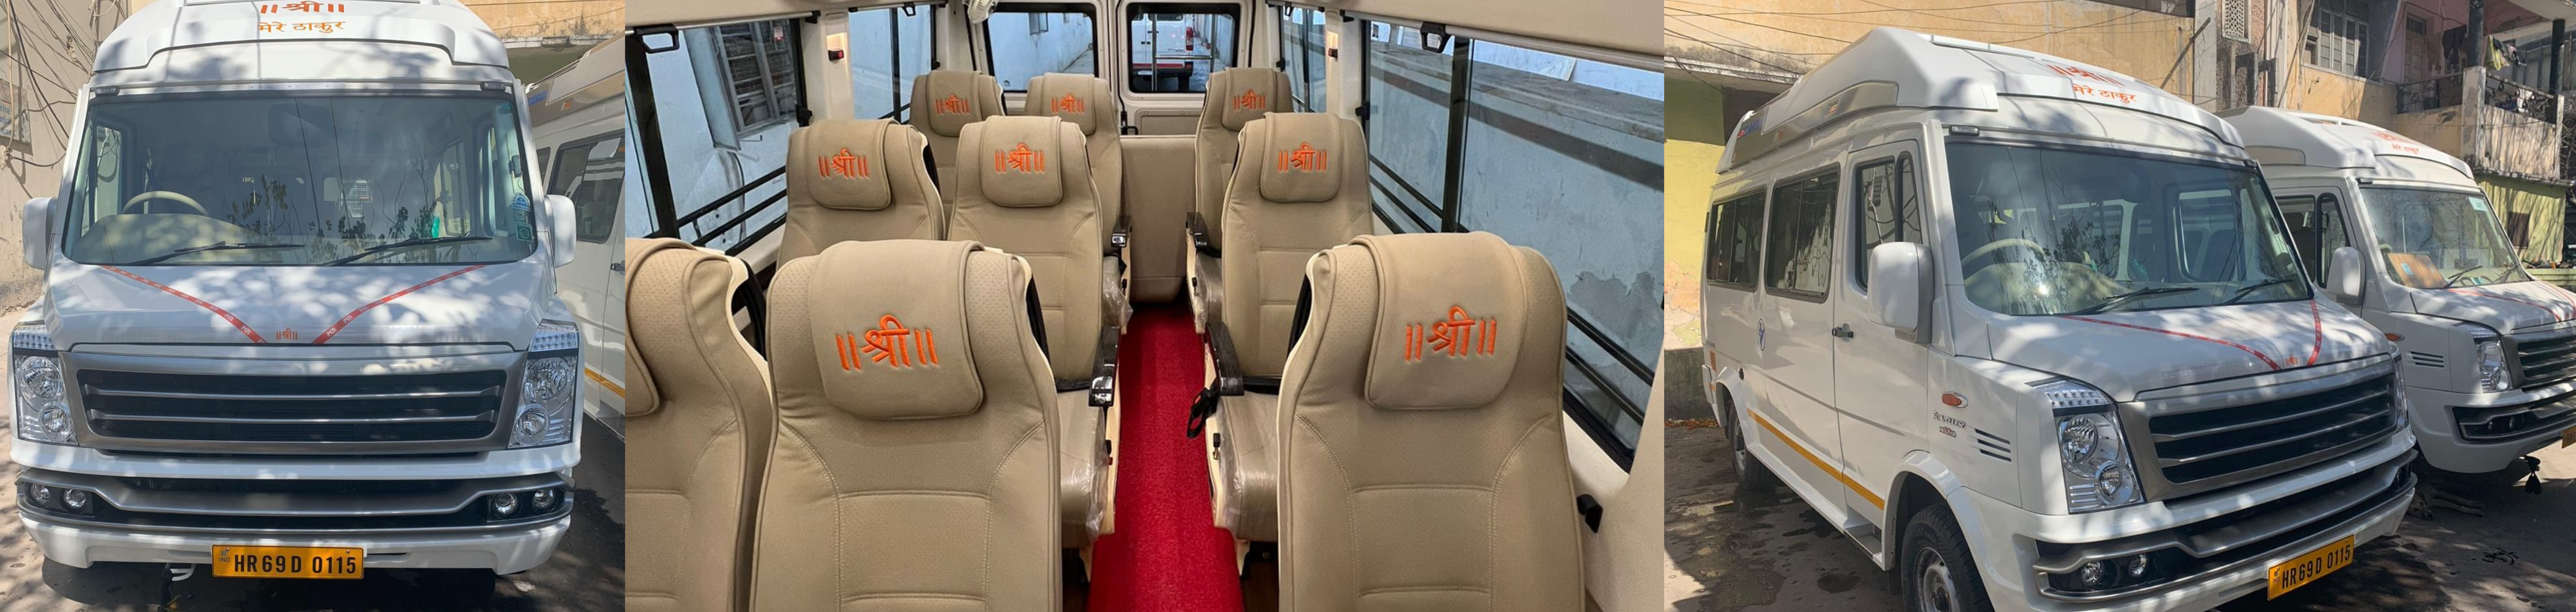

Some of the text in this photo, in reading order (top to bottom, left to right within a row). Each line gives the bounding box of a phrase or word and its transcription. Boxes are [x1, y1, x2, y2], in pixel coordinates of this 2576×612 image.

[257, 21, 346, 33] मेरे ठाकुर
[2073, 83, 2137, 103] मेरे ठाकुर
[1933, 411, 1966, 428] TRAVELLER
[312, 556, 356, 574] 0115
[2327, 544, 2350, 569] 0115
